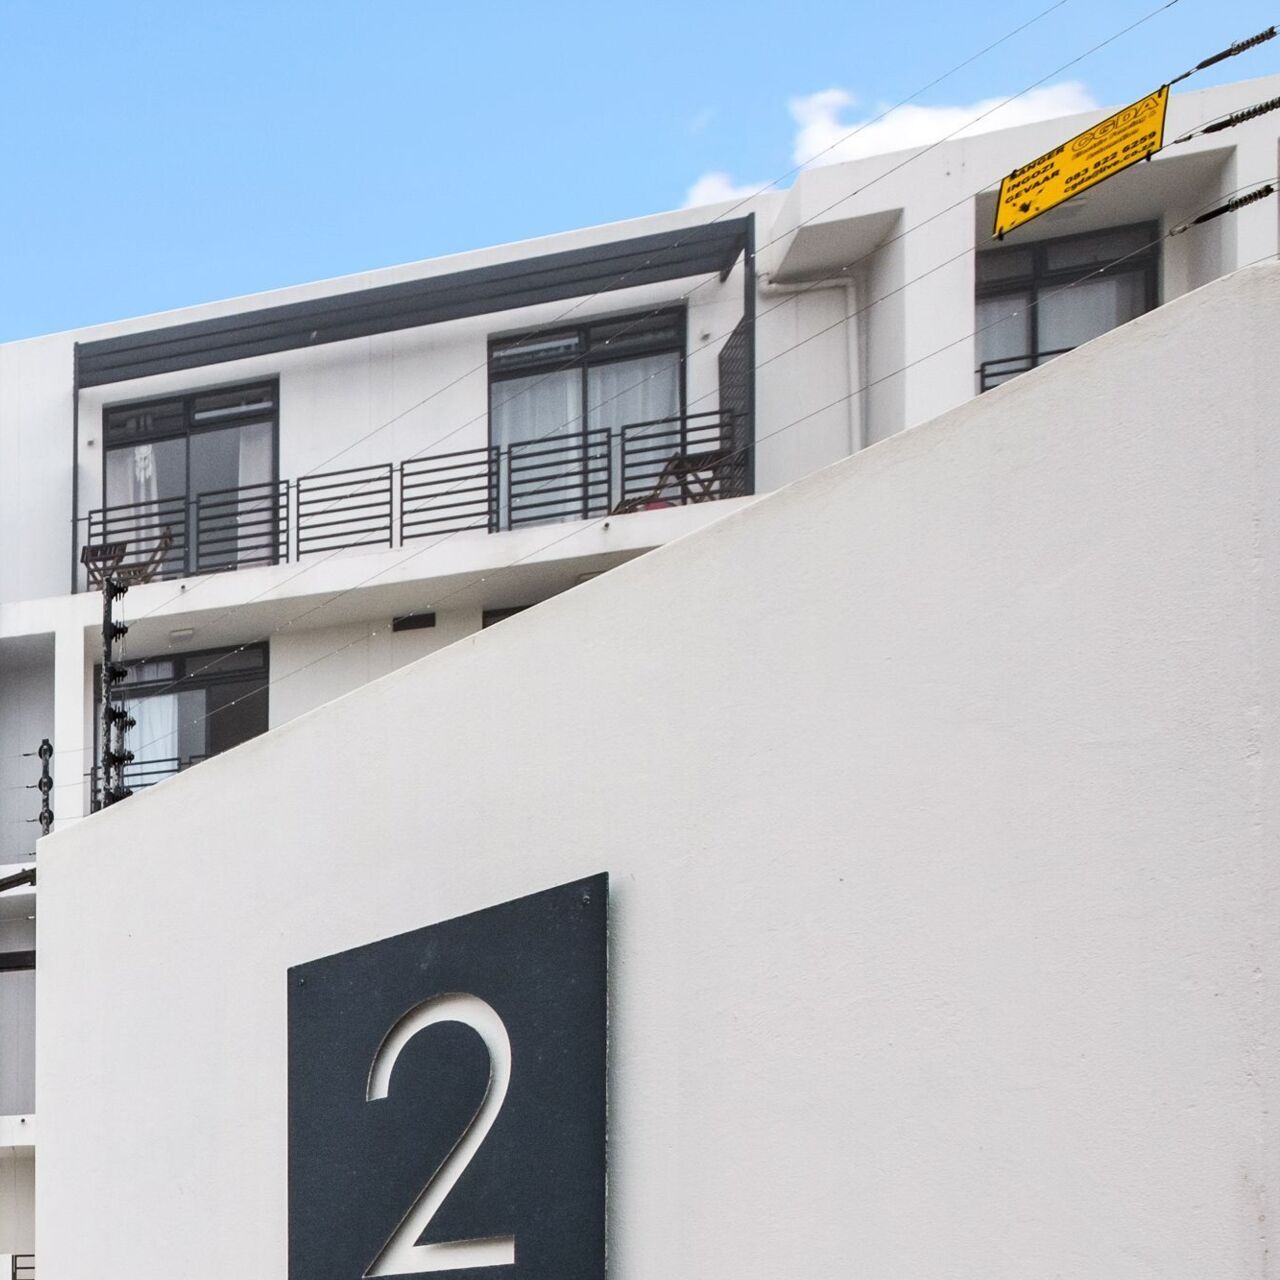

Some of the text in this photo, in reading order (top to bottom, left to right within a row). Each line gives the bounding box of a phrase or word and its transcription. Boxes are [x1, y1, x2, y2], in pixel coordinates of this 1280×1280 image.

[1071, 97, 1159, 152] CGDA
[1005, 169, 1060, 204] GEVAAR
[1007, 162, 1054, 193] INGOZI
[1064, 167, 1088, 184] 083
[362, 991, 515, 1278] 2
